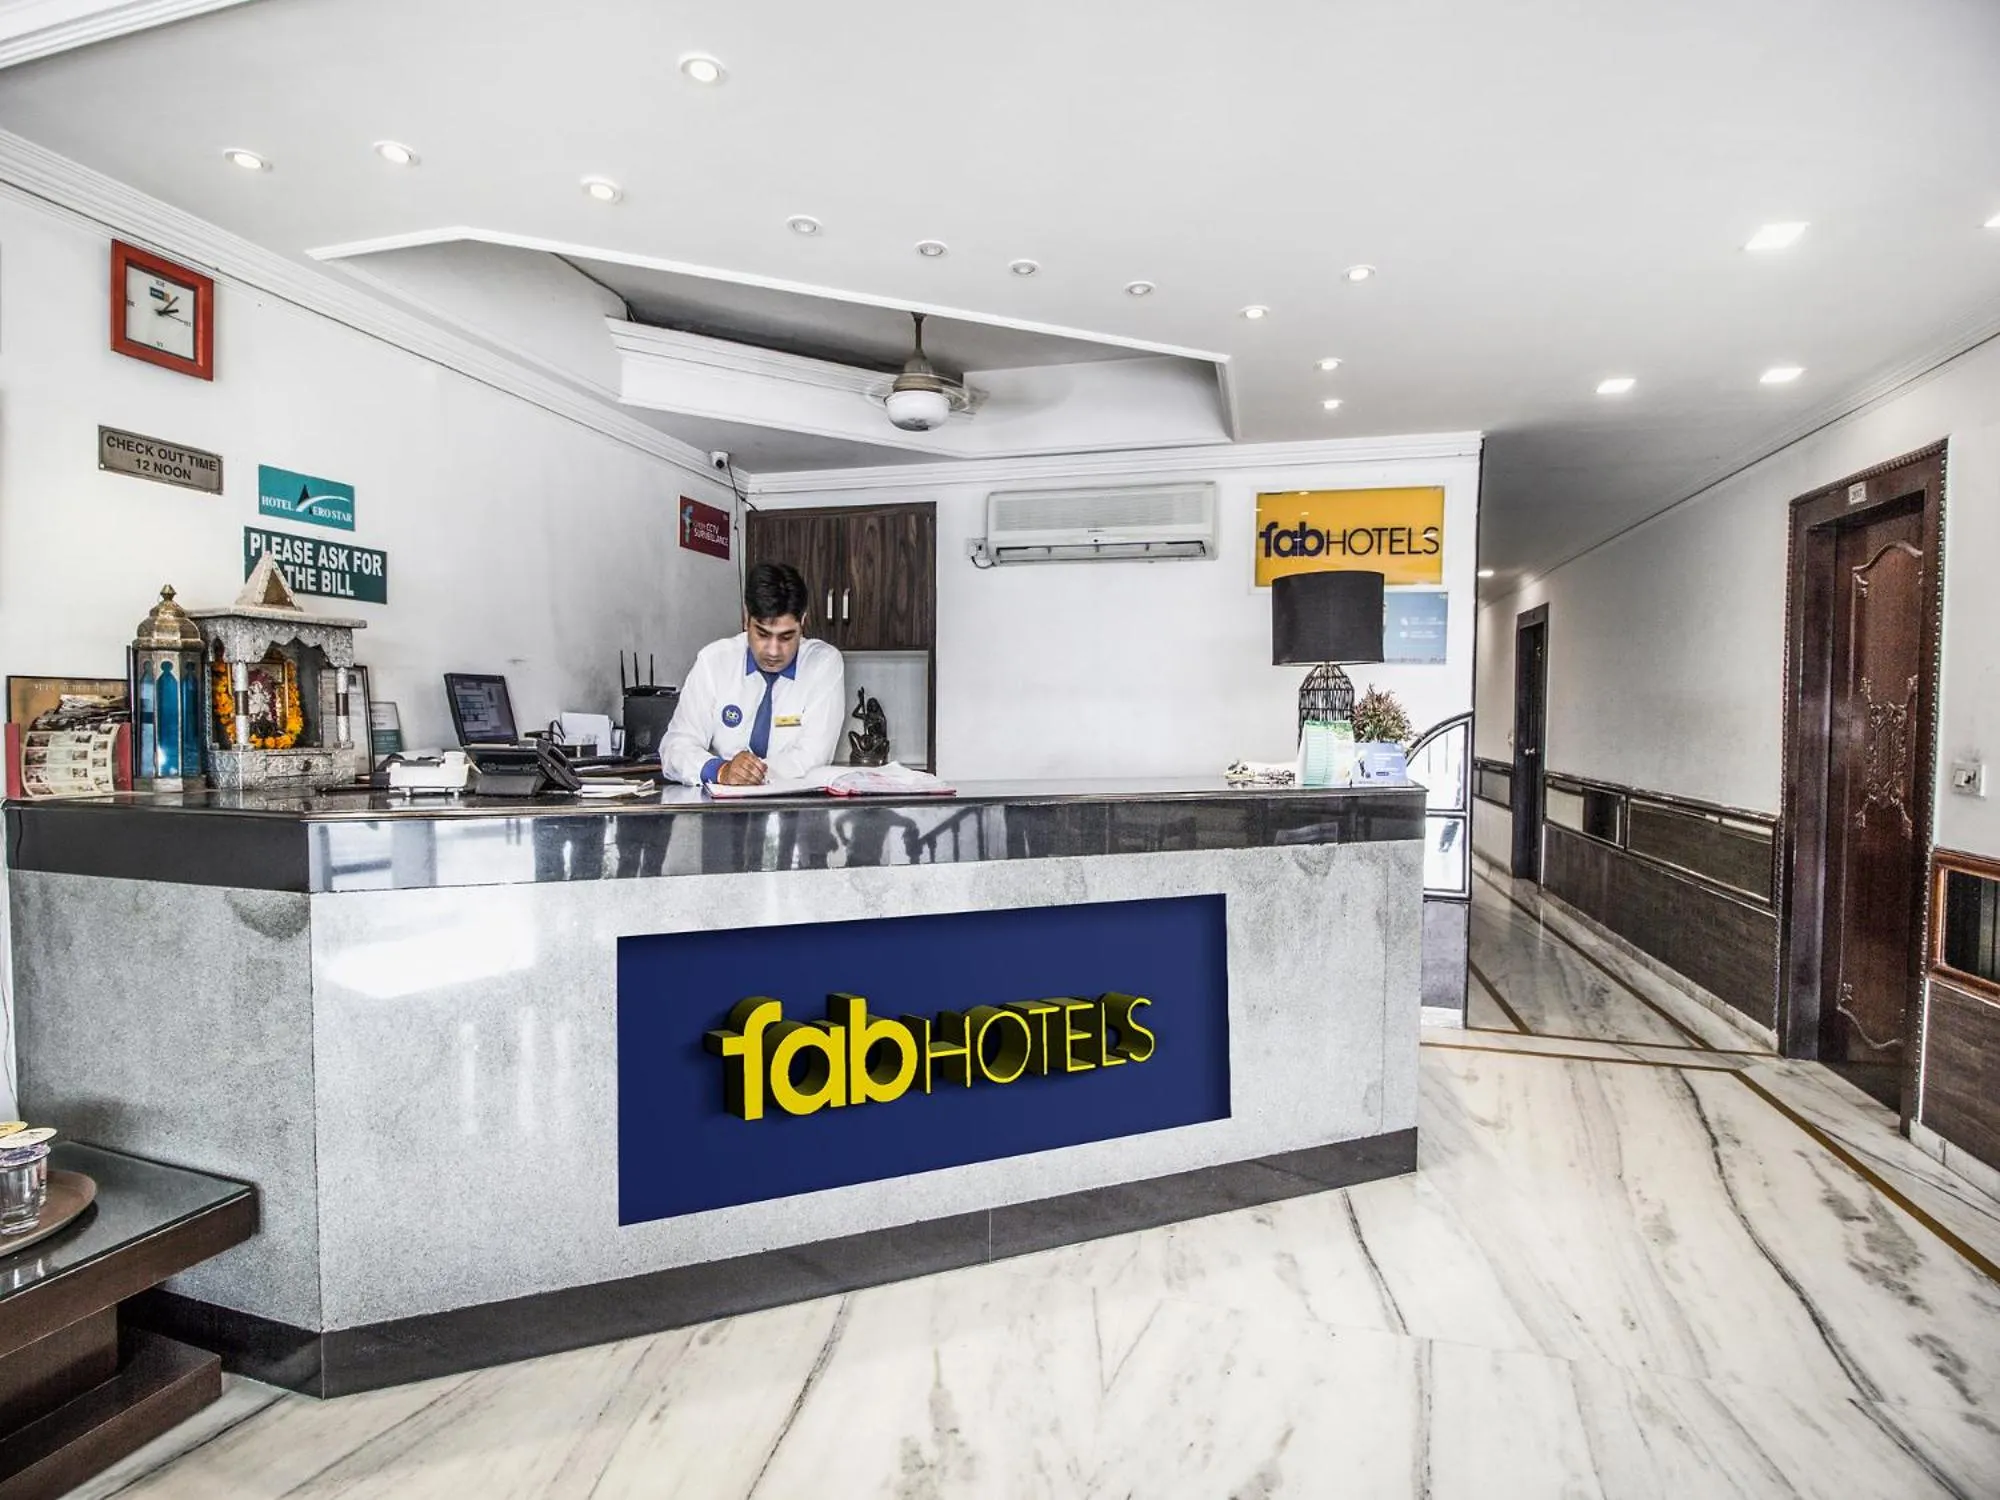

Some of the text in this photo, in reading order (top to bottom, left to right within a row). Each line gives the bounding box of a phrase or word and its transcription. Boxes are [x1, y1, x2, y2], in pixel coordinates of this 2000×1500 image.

[106, 435, 217, 472] CHECK OUT TIME
[135, 458, 192, 481] 12 NOON
[261, 496, 294, 511] HOTEL
[1259, 521, 1440, 558] fabHOTELS
[317, 545, 349, 572] ASK
[352, 551, 383, 577] FOR
[283, 564, 355, 597] THE BILL
[718, 997, 1156, 1120] fabHOTELS
